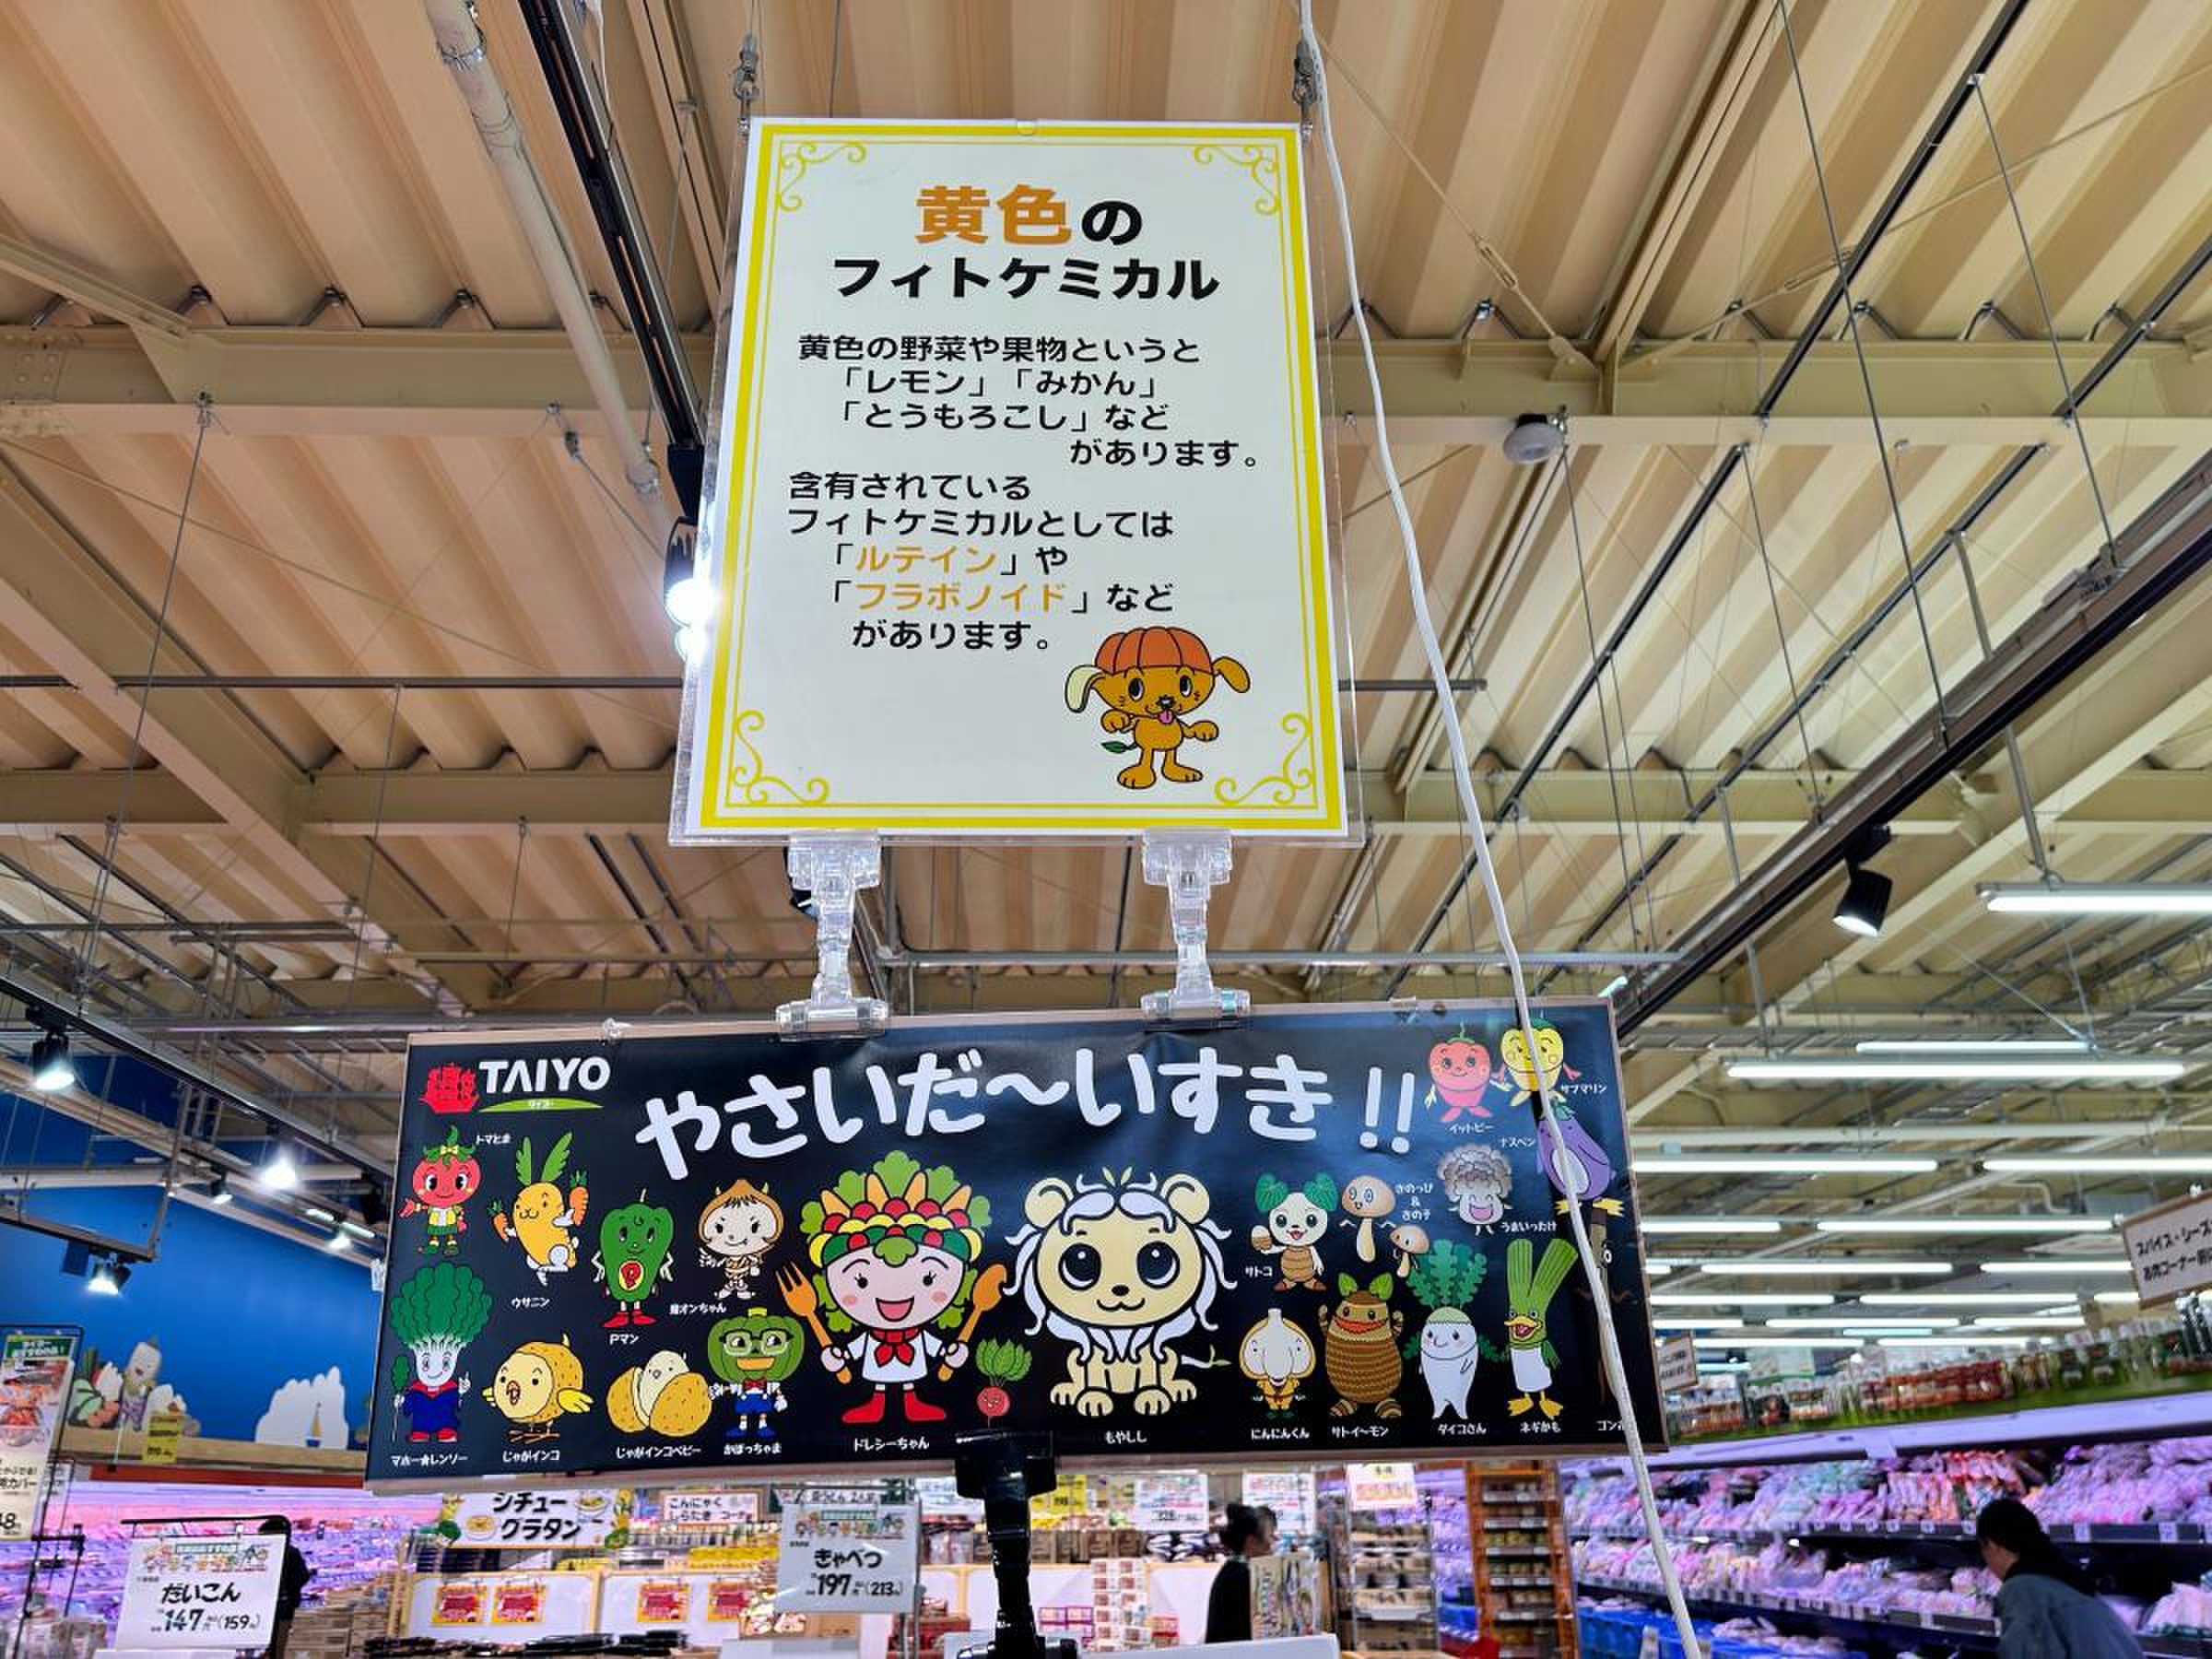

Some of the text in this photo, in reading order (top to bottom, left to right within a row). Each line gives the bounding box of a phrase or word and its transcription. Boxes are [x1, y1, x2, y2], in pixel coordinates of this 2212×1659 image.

[914, 182, 1142, 245] 黄色の
[833, 258, 1219, 300] フィトケミカル
[798, 335, 1199, 363] 黄色の野菜や果物というと
[843, 402, 1169, 432] 「とうもろこし」など
[1070, 439, 1256, 467] があります。
[790, 471, 1030, 500] 含有されている
[789, 509, 1173, 537] フィトケミカルとしては
[835, 544, 1068, 576] 「ルテイン」や
[833, 581, 1173, 615] 「フラボノイド」など
[853, 619, 1048, 651] があります。
[478, 1056, 611, 1093] TAIYO
[1245, 1265, 1273, 1277] サトコ
[511, 1297, 551, 1310] ウサニン
[609, 1334, 640, 1345] Pマン
[854, 1436, 930, 1453] ドレシーちゃん
[1105, 1430, 1147, 1444] もやしし
[502, 1450, 560, 1463] じゃがインコ
[493, 1491, 568, 1512] シチュー
[501, 1518, 582, 1540] グラタン
[814, 1547, 883, 1569] きゃべつ
[161, 1582, 241, 1605] だいこん
